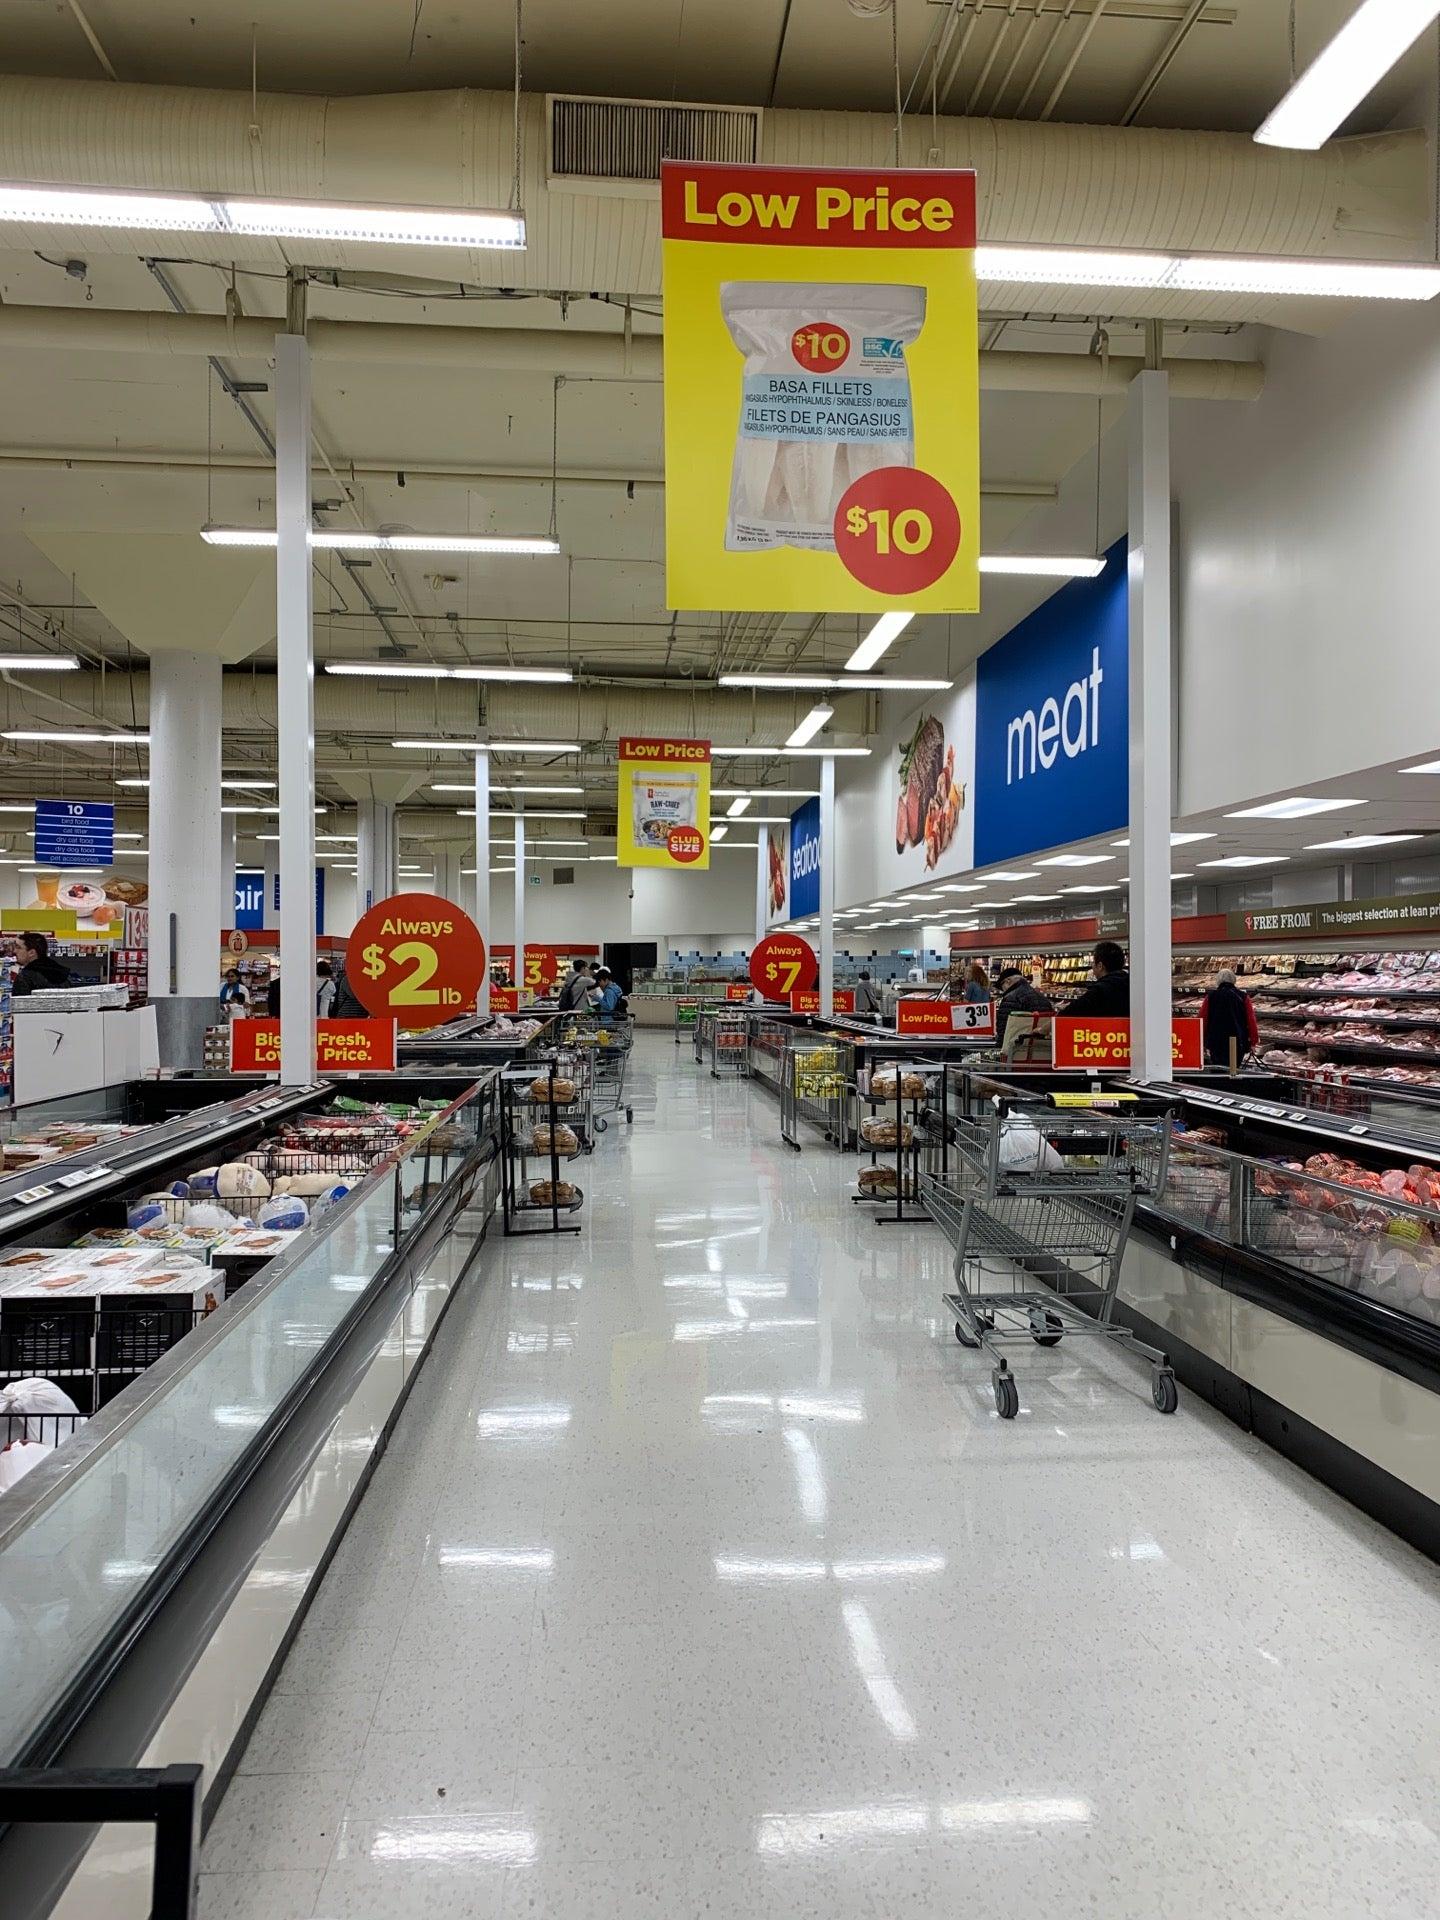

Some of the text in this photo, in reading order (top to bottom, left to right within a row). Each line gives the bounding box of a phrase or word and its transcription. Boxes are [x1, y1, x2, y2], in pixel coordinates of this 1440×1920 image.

[685, 181, 953, 231] Low Price
[796, 333, 846, 359] $10
[769, 380, 872, 396] BASA FILLETS
[769, 395, 832, 406] HYPOPHTHALMUS
[837, 397, 872, 407] SKINLESS
[747, 408, 901, 427] FILETS DE PANGASIUS
[766, 424, 823, 436] HYPOPHTHALMUS
[828, 426, 846, 436] SANS
[847, 428, 866, 437] PEAU
[870, 428, 888, 437] SANS
[845, 505, 933, 555] $10
[1007, 646, 1103, 786] meat
[625, 742, 705, 758] Low Price
[67, 804, 84, 815] 10
[56, 836, 67, 844] dry
[671, 836, 700, 844] CLUB
[55, 845, 66, 853] dry
[671, 843, 700, 853] SIZE
[50, 855, 61, 864] pet
[1253, 914, 1279, 930] FREE
[1280, 912, 1311, 929] FROM
[1322, 912, 1335, 923] The
[1336, 910, 1363, 924] biggest
[1364, 908, 1398, 920] selection
[1400, 906, 1409, 918] at
[1410, 905, 1428, 917] lean
[380, 918, 453, 937] Always
[766, 946, 802, 957] Always
[766, 962, 802, 994] $7
[902, 1014, 923, 1023] Low
[923, 1014, 948, 1023] Price
[318, 1032, 371, 1047] Fresh,
[1073, 1029, 1127, 1044] Big on
[324, 1048, 372, 1061] Price.
[1073, 1045, 1131, 1058] Low on
